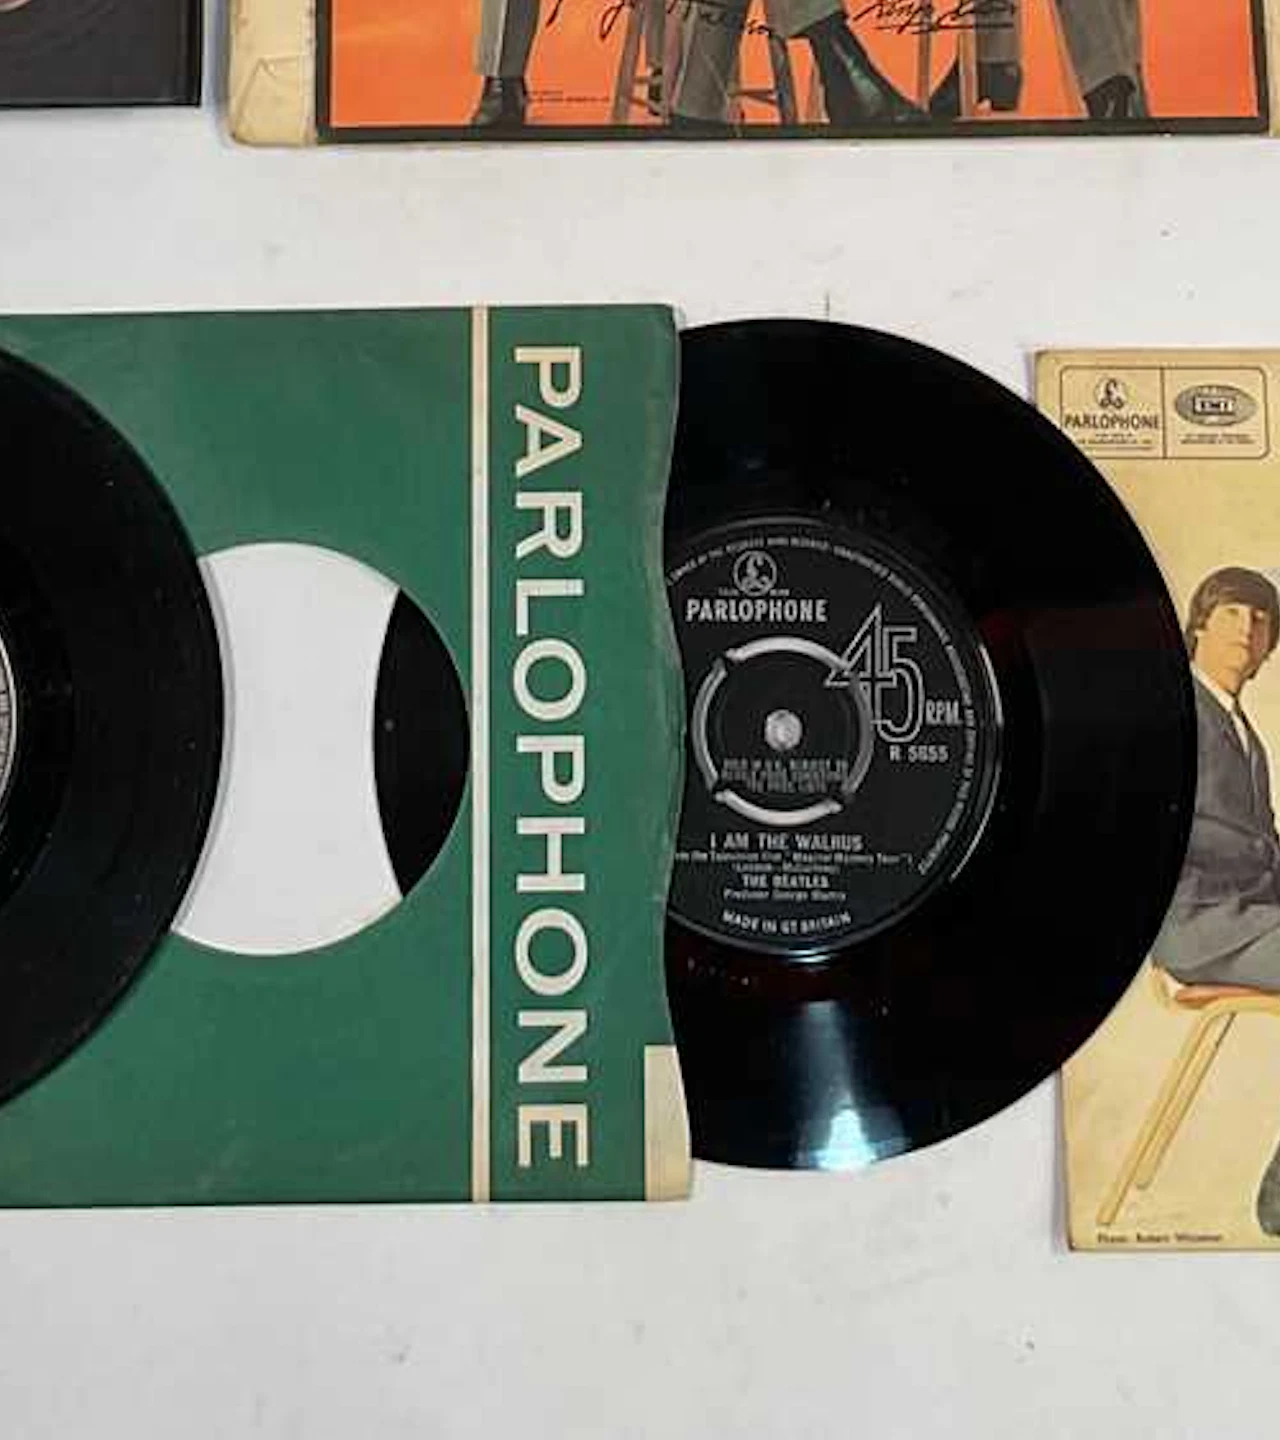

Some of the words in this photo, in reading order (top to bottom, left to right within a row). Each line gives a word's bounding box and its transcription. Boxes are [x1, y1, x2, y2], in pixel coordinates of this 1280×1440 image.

[1064, 414, 1159, 430] PARLOPHONE
[685, 598, 829, 623] PARLOPHONE
[824, 603, 924, 742] 45
[925, 699, 962, 725] RPM
[513, 345, 588, 1167] PARLOPHONE
[889, 744, 903, 762] R
[723, 832, 750, 850] AM
[758, 833, 789, 850] THE
[795, 833, 864, 851] WALRUS
[772, 873, 830, 888] BEATLES
